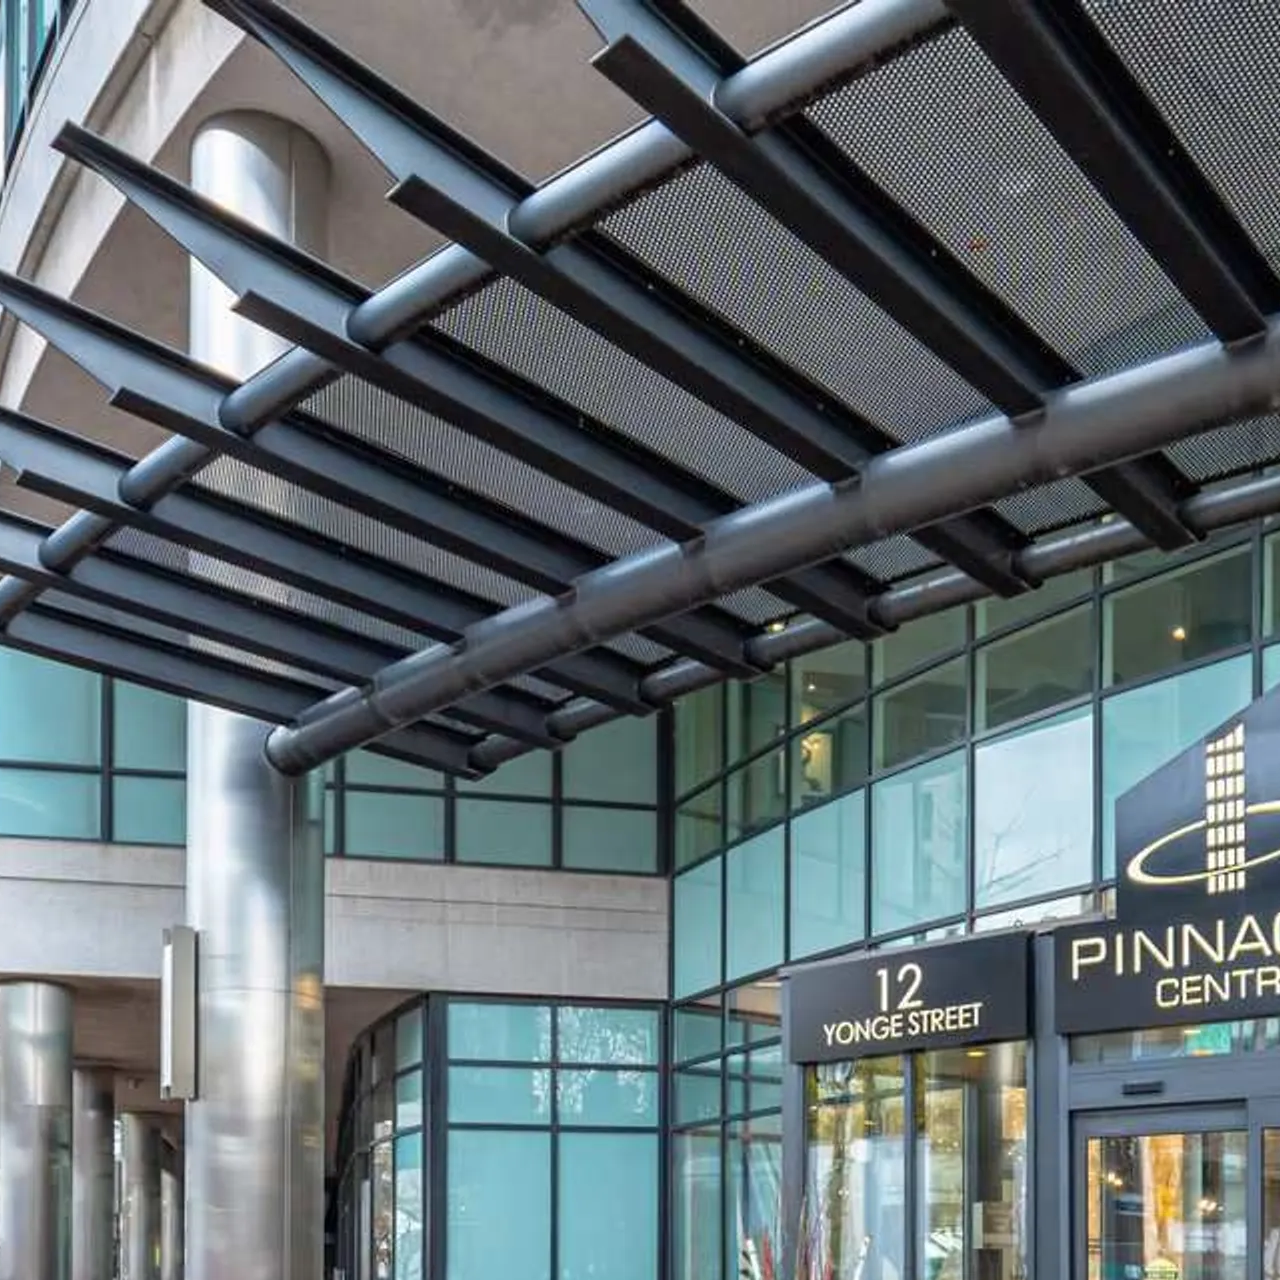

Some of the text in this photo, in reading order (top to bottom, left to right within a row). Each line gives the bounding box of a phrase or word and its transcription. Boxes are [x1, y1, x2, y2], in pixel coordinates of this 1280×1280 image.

[876, 963, 923, 1012] 12
[823, 1002, 983, 1046] YONGE STREET
